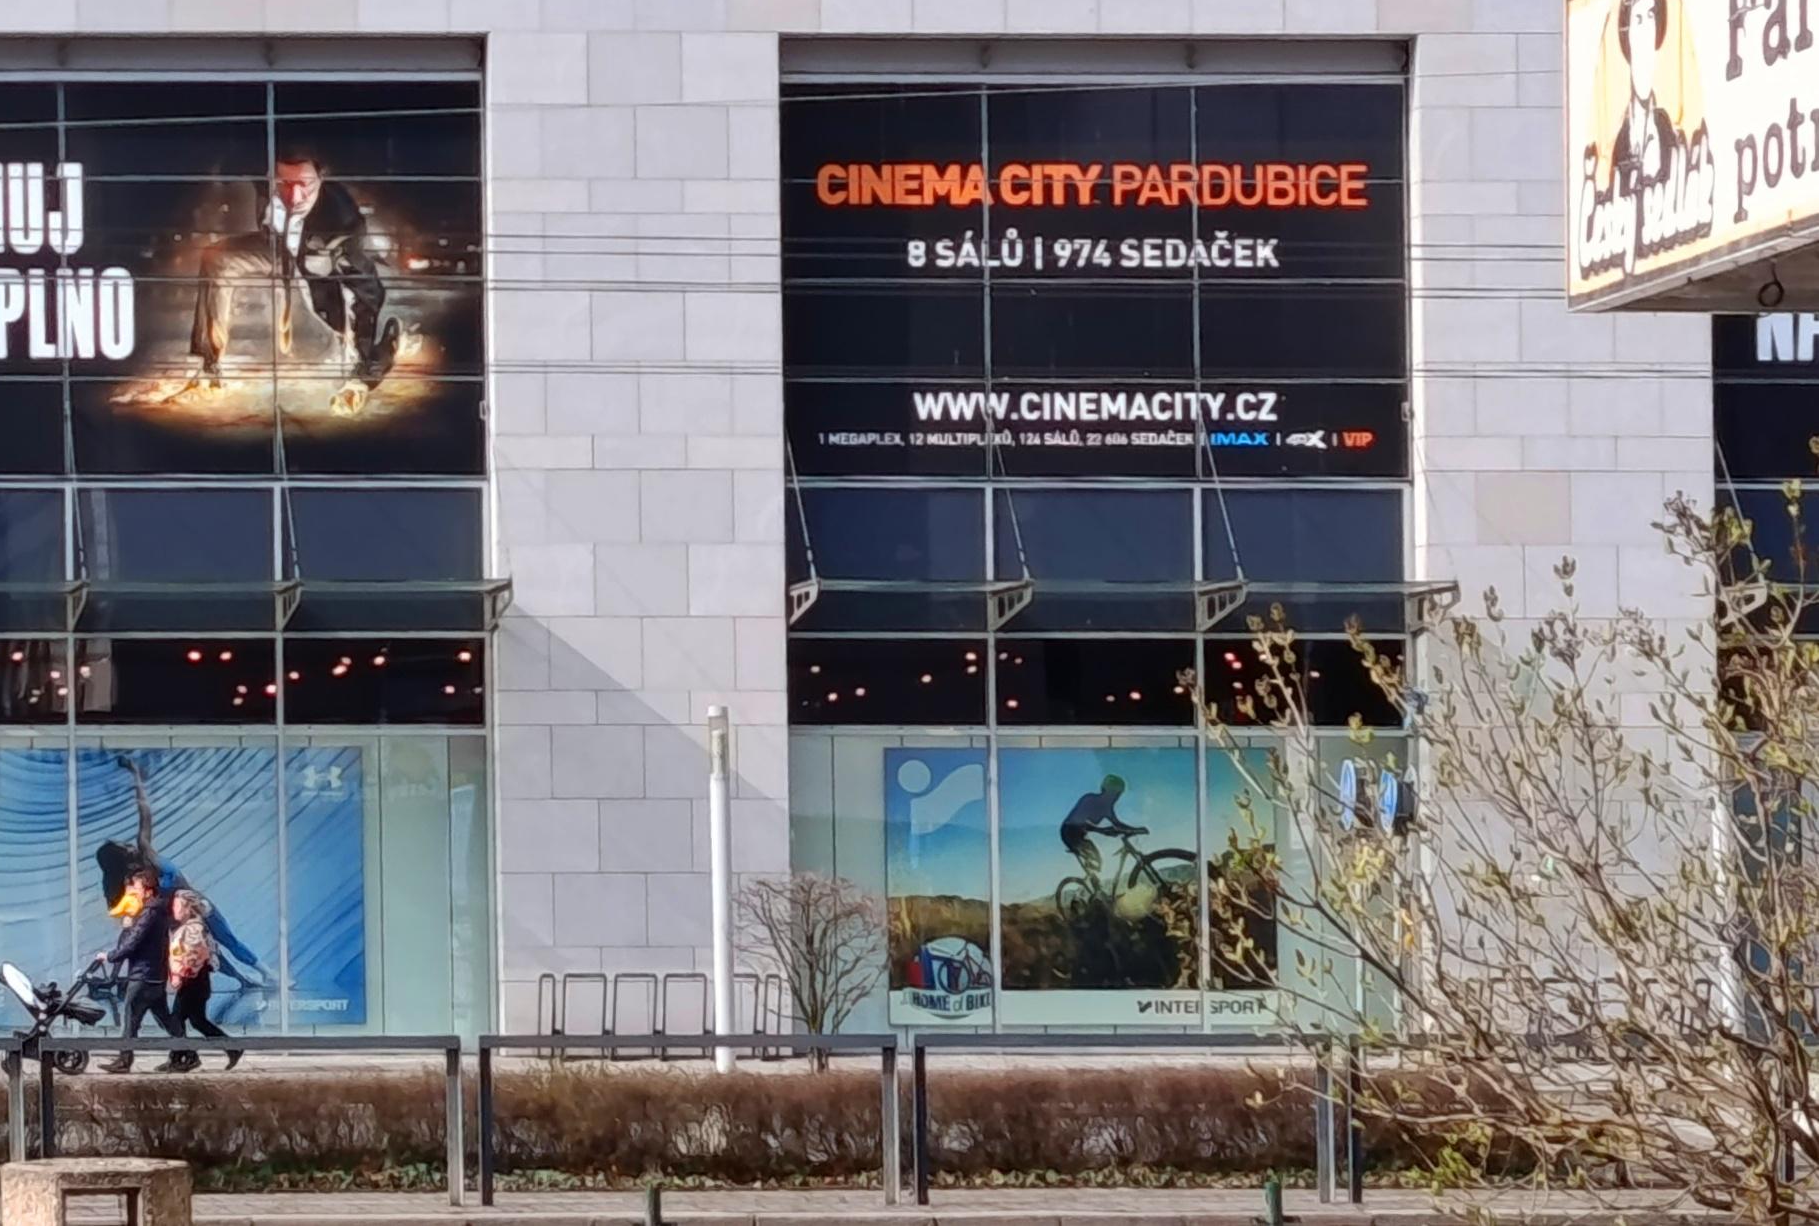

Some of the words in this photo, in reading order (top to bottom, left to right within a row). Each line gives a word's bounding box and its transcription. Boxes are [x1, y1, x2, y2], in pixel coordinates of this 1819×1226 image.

[816, 163, 994, 206] CINEMA
[999, 163, 1103, 206] CITY
[1113, 163, 1369, 206] PARDUBICE
[907, 240, 926, 268] 8
[935, 228, 1023, 268] SÁLŮ
[1053, 238, 1112, 268] 974
[1120, 230, 1280, 268] SEDAČEK
[913, 392, 1278, 422] WWW.CINEMACITY.CZ
[1211, 432, 1269, 445] IMAX
[1343, 432, 1374, 445] VIP
